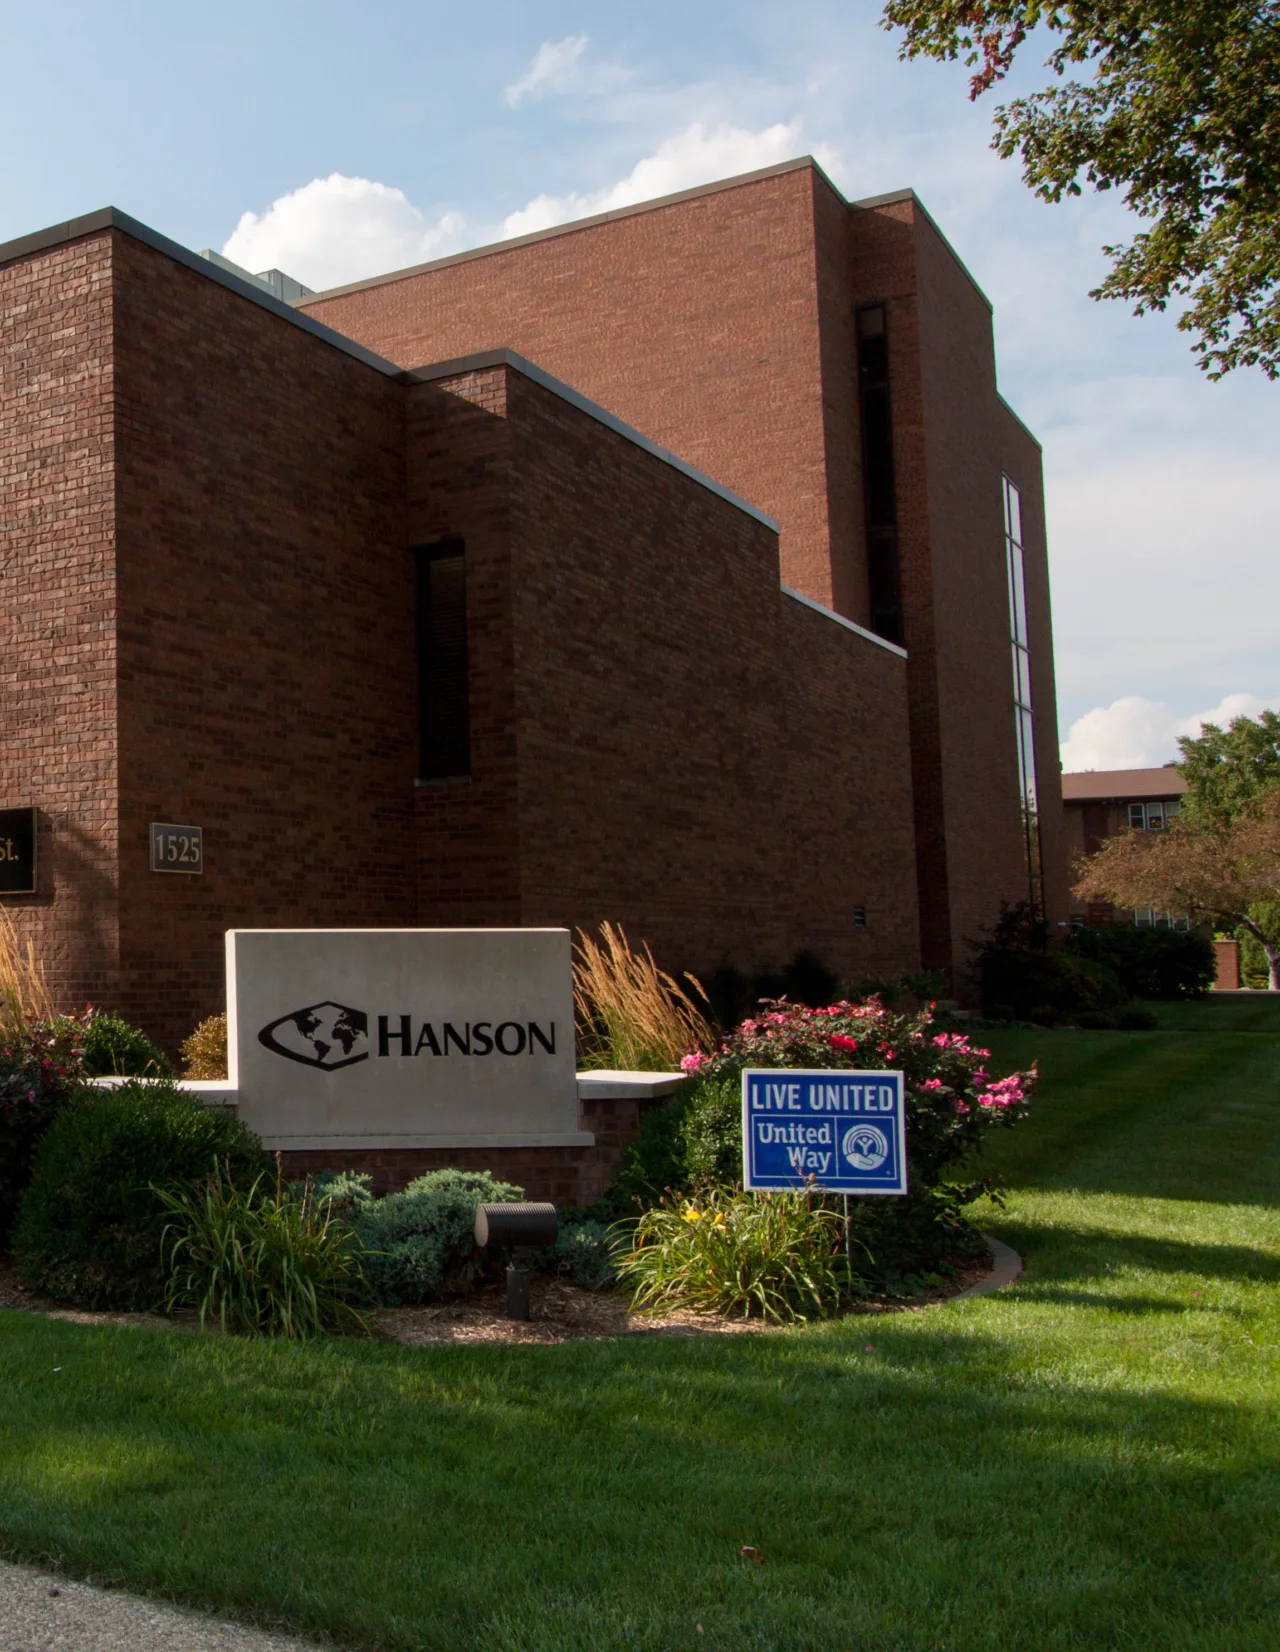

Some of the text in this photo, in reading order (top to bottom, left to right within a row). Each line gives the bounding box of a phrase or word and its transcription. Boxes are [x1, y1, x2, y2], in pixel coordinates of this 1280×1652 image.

[156, 833, 200, 863] 1525
[377, 1014, 557, 1057] HANSON
[751, 1083, 894, 1112] LIVE UNITED
[757, 1122, 832, 1145] United
[786, 1146, 833, 1174] Way
